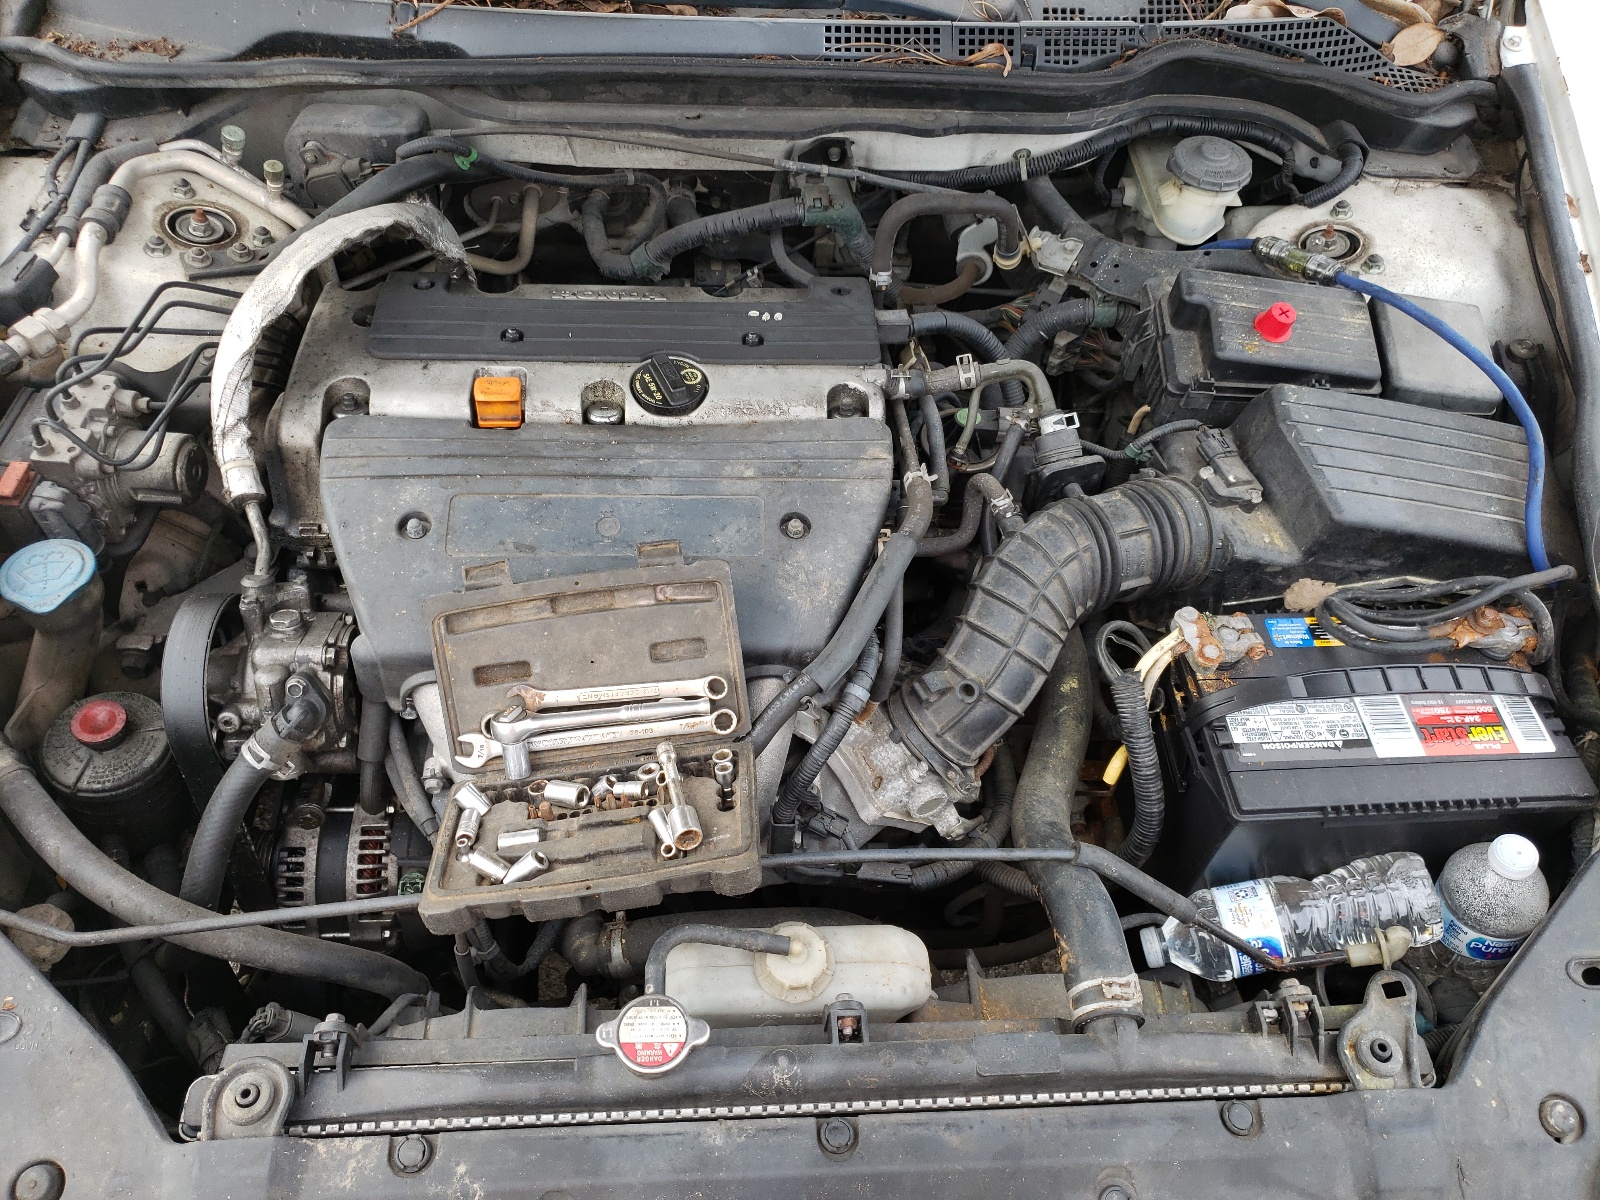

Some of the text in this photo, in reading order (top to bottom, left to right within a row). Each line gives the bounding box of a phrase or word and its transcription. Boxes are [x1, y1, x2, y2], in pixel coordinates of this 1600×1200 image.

[1454, 715, 1481, 723] 24F-3
[1420, 725, 1511, 747] EverStart
[1262, 741, 1335, 750] DANGER/POISON
[1450, 919, 1469, 936] Purified
[1470, 942, 1508, 954] Pure
